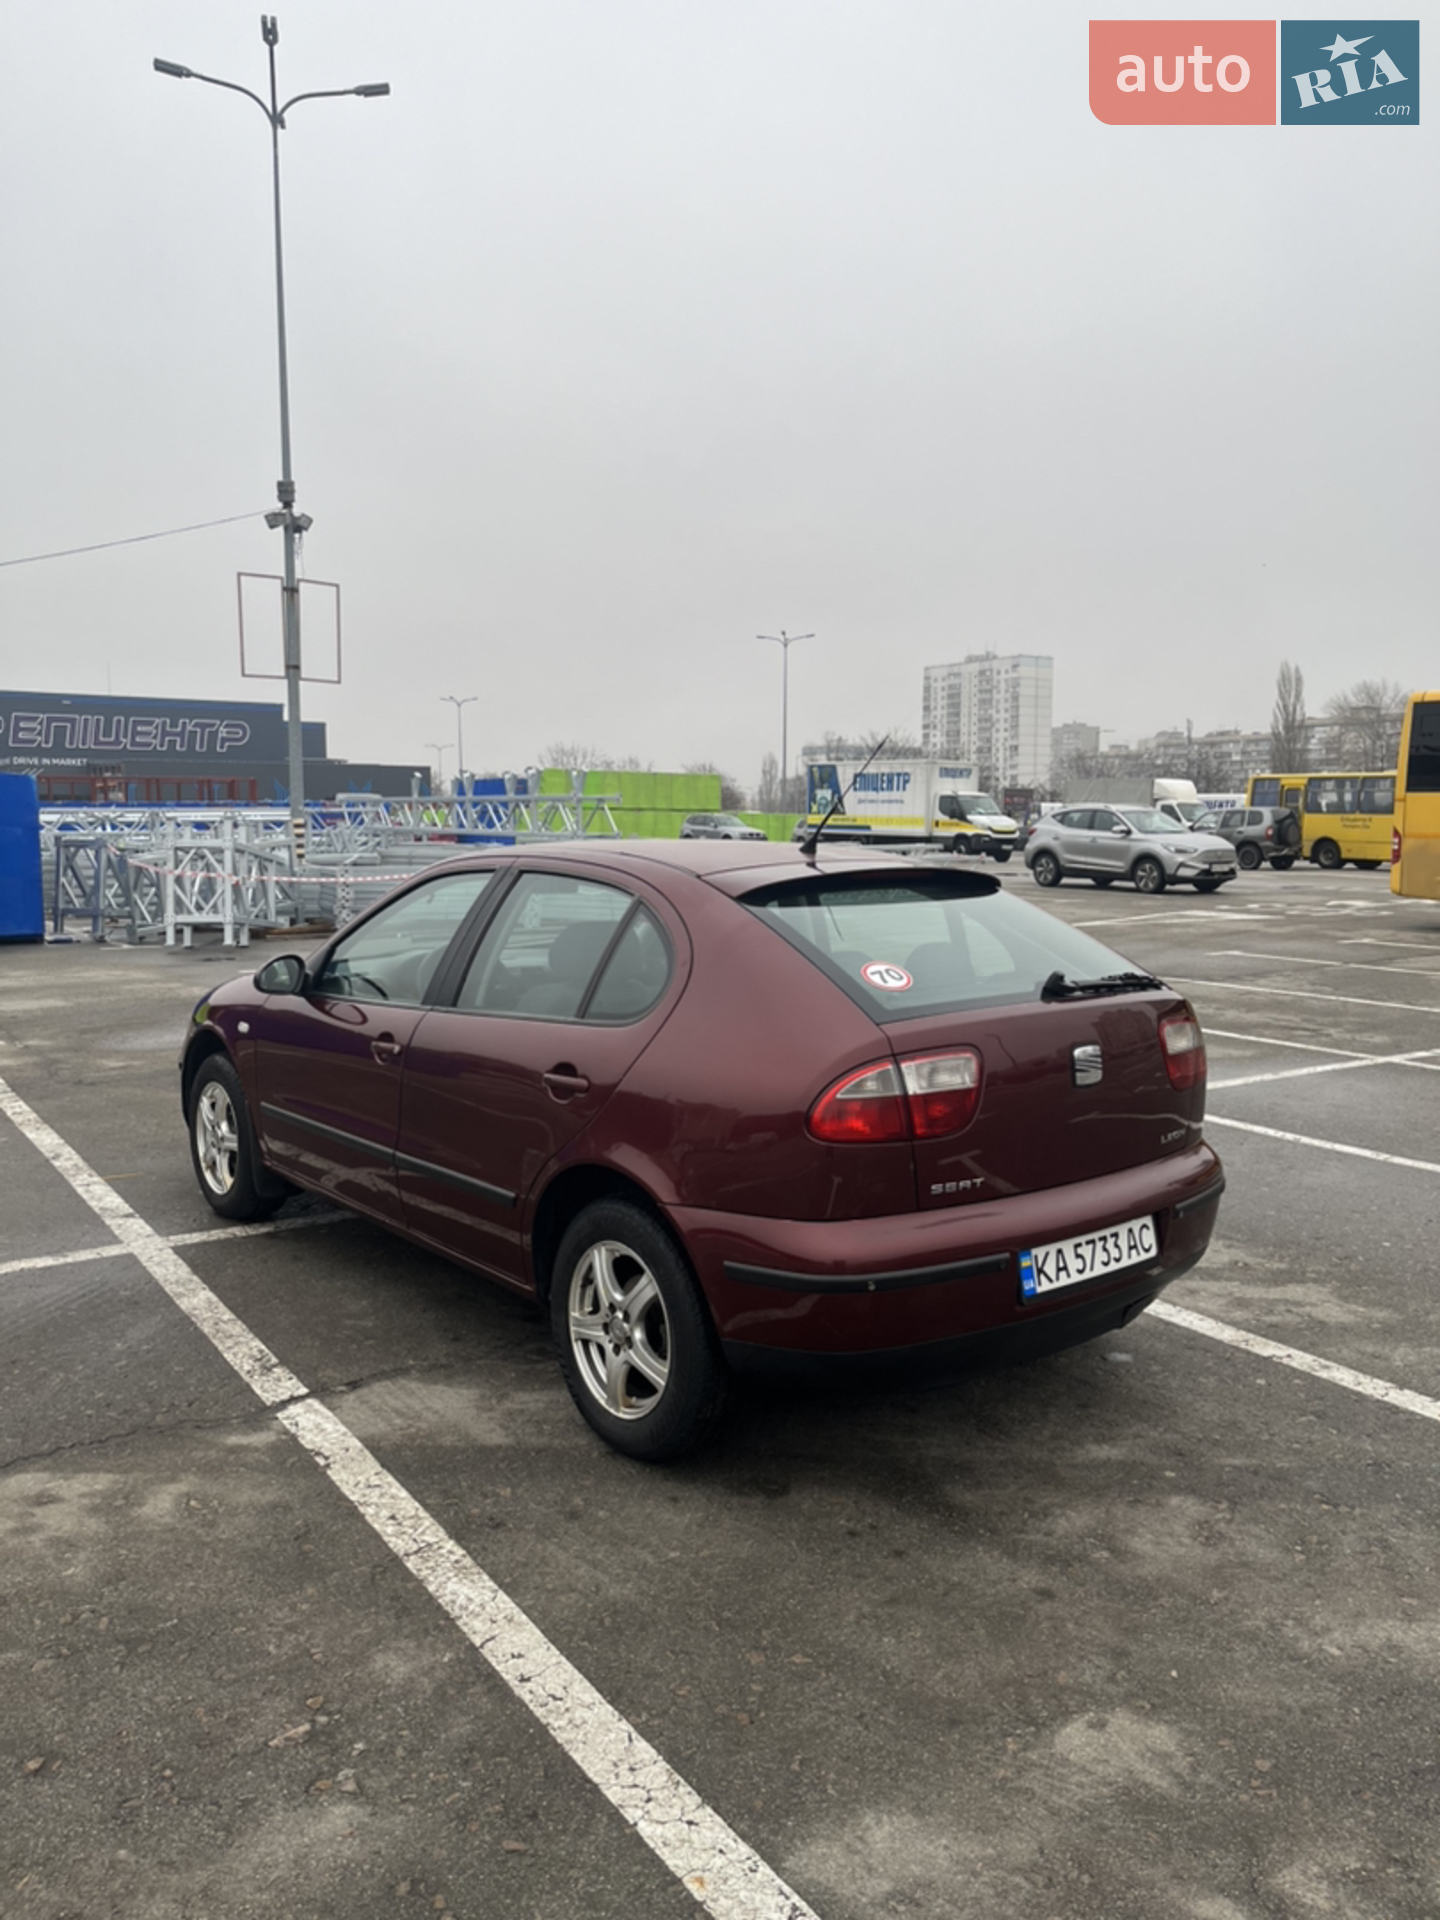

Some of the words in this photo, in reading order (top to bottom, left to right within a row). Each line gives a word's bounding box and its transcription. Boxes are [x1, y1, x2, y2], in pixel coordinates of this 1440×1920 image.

[8, 712, 250, 752] ЕПІЦЕНТР
[12, 756, 39, 766] DRIVE
[41, 757, 51, 766] IN
[52, 757, 88, 767] MARKET
[869, 967, 904, 984] 70
[931, 1177, 985, 1195] SEAT
